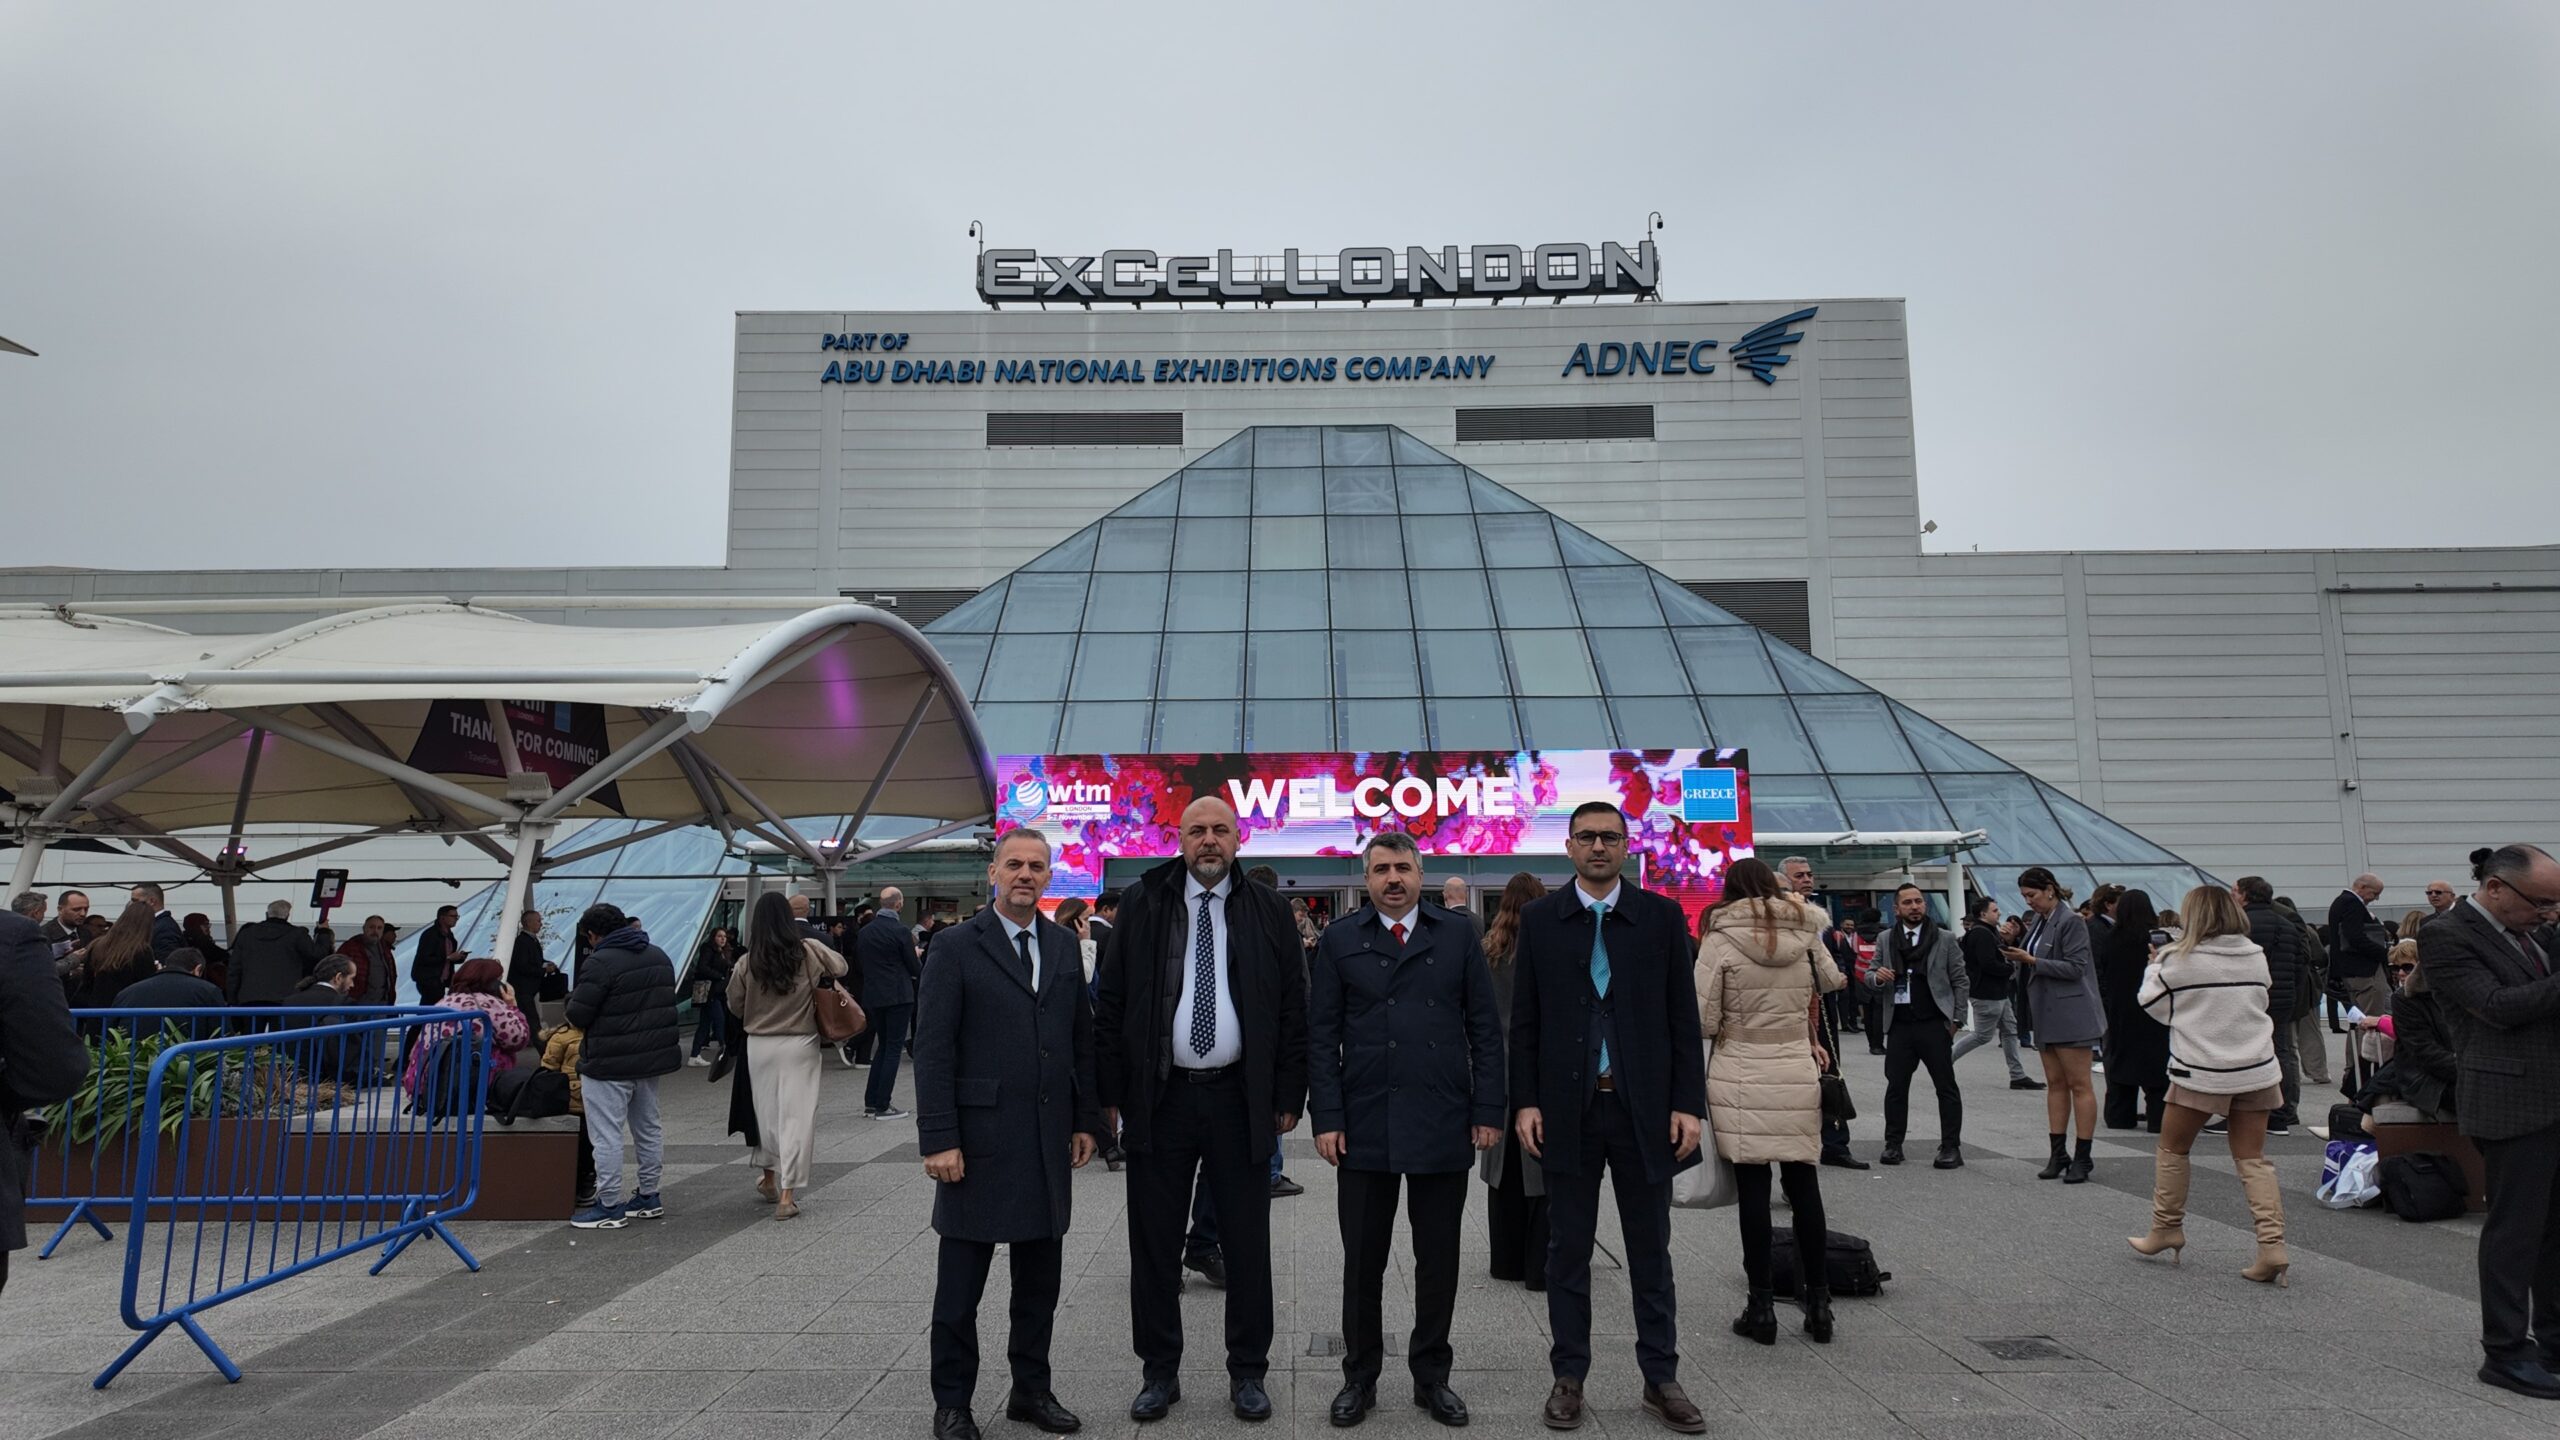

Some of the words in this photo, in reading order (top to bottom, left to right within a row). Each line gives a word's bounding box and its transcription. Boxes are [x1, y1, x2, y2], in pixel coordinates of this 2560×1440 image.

[1284, 240, 1656, 296] LONDON
[821, 333, 876, 350] PART
[879, 333, 909, 350] OF
[1562, 339, 1718, 377] ADNEC
[821, 360, 885, 383] ABU
[890, 359, 986, 383] DHABI
[994, 358, 1146, 383] NATIONAL
[1153, 357, 1338, 383] EXHIBITIONS
[1344, 355, 1495, 380] COMPANY
[450, 712, 497, 744] THAN
[516, 729, 542, 754] FOR
[545, 737, 599, 767] COMING!
[1048, 779, 1111, 802] wtm
[1227, 777, 1516, 818] WELCOME
[1684, 788, 1735, 799] GREECE
